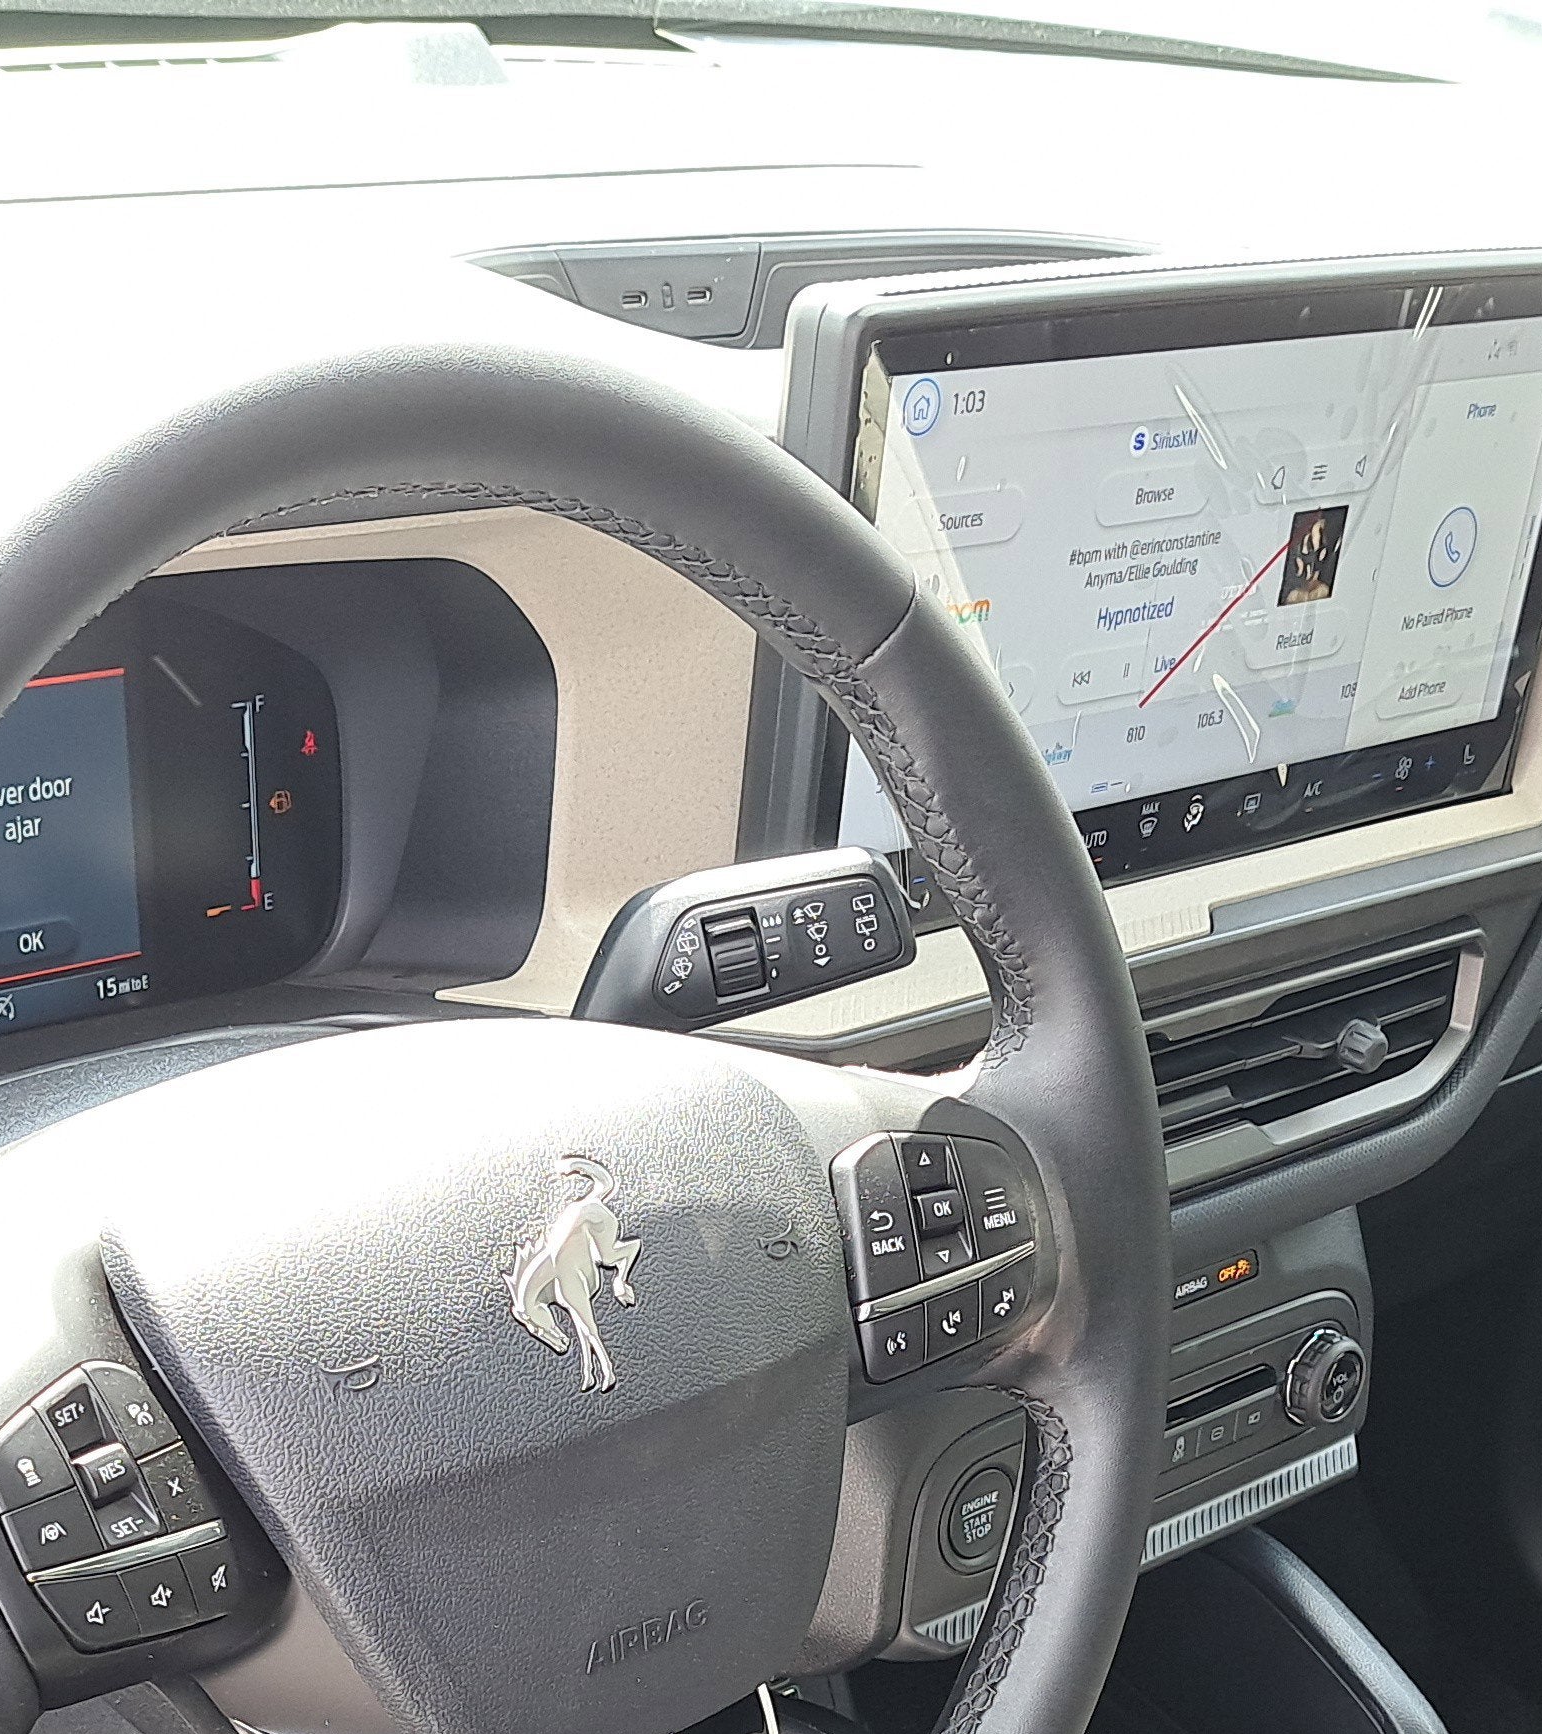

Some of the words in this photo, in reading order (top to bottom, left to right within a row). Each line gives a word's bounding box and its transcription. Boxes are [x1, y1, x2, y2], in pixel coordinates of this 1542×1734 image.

[953, 389, 986, 415] 1:03
[1466, 402, 1497, 419] Phone
[1150, 429, 1198, 451] SiriusXM
[1135, 487, 1175, 505] Browse
[938, 512, 984, 532] Sources
[1068, 549, 1102, 567] #bpm
[1104, 542, 1128, 561] with
[1129, 531, 1222, 560] @erinconstantine
[1083, 564, 1151, 589] Anyma/Ellie
[1152, 557, 1199, 578] Goulding
[1097, 596, 1175, 631] Hypnotized
[1401, 615, 1414, 632] No
[1414, 609, 1445, 630] Paired
[1445, 604, 1474, 621] Phone
[1275, 629, 1315, 651] Related
[1154, 654, 1177, 674] Live
[1397, 685, 1416, 702] Add
[1417, 680, 1447, 698] Phone
[255, 694, 265, 713] F
[1197, 709, 1224, 729] 106.3
[1126, 725, 1146, 743] 810
[28, 776, 73, 802] door
[1303, 780, 1324, 798] A/C
[1140, 802, 1160, 816] MAX
[4, 815, 42, 844] ajar
[1084, 829, 1107, 849] UTO
[264, 892, 274, 911] E
[18, 929, 46, 954] OK
[96, 976, 117, 1000] 15
[932, 1202, 953, 1218] OK
[983, 1210, 1017, 1231] MENU
[871, 1235, 906, 1256] BACK
[1174, 1276, 1209, 1300] AIRBAG
[1217, 1265, 1237, 1283] OFF
[1332, 1373, 1349, 1387] VOL
[54, 1401, 87, 1427] SET+
[97, 1459, 126, 1485] RES
[961, 1490, 999, 1516] ENGINE
[963, 1510, 994, 1533] START
[965, 1523, 992, 1544] STOP
[585, 1598, 709, 1676] AIRBAG
